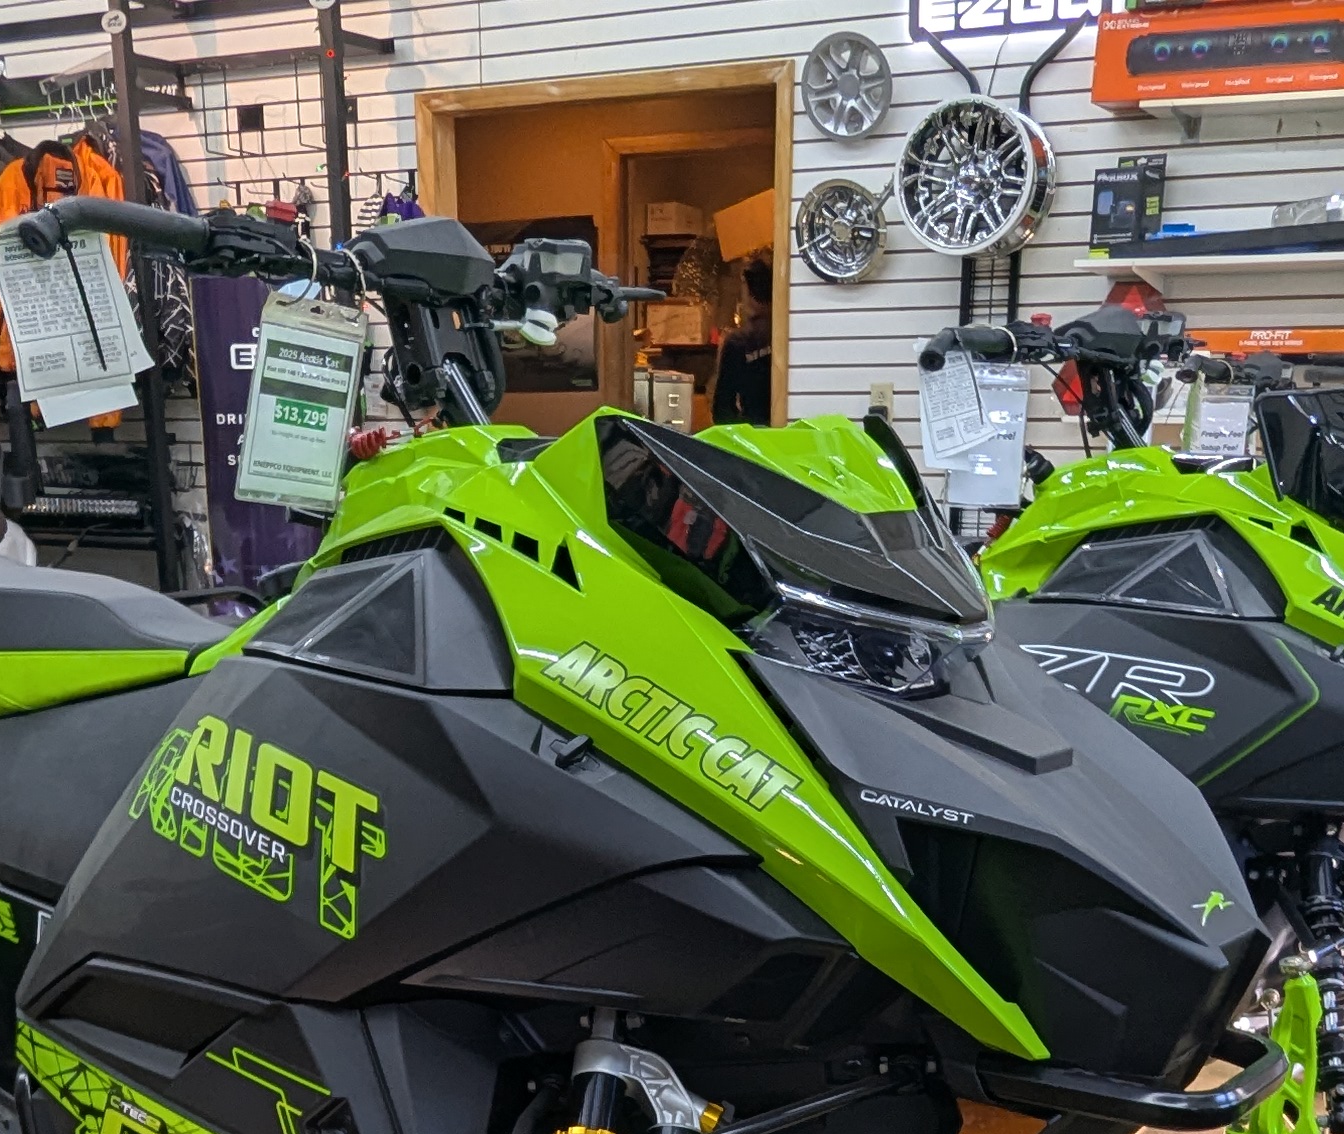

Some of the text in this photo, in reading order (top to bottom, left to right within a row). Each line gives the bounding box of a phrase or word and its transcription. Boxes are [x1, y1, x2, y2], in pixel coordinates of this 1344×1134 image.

[275, 404, 328, 427] $13,799
[543, 640, 804, 813] ARCTIC CAT
[1108, 694, 1217, 736] RXC
[169, 785, 287, 865] CROSSOVER
[174, 714, 380, 875] RIOT
[859, 788, 976, 826] CATALYST
